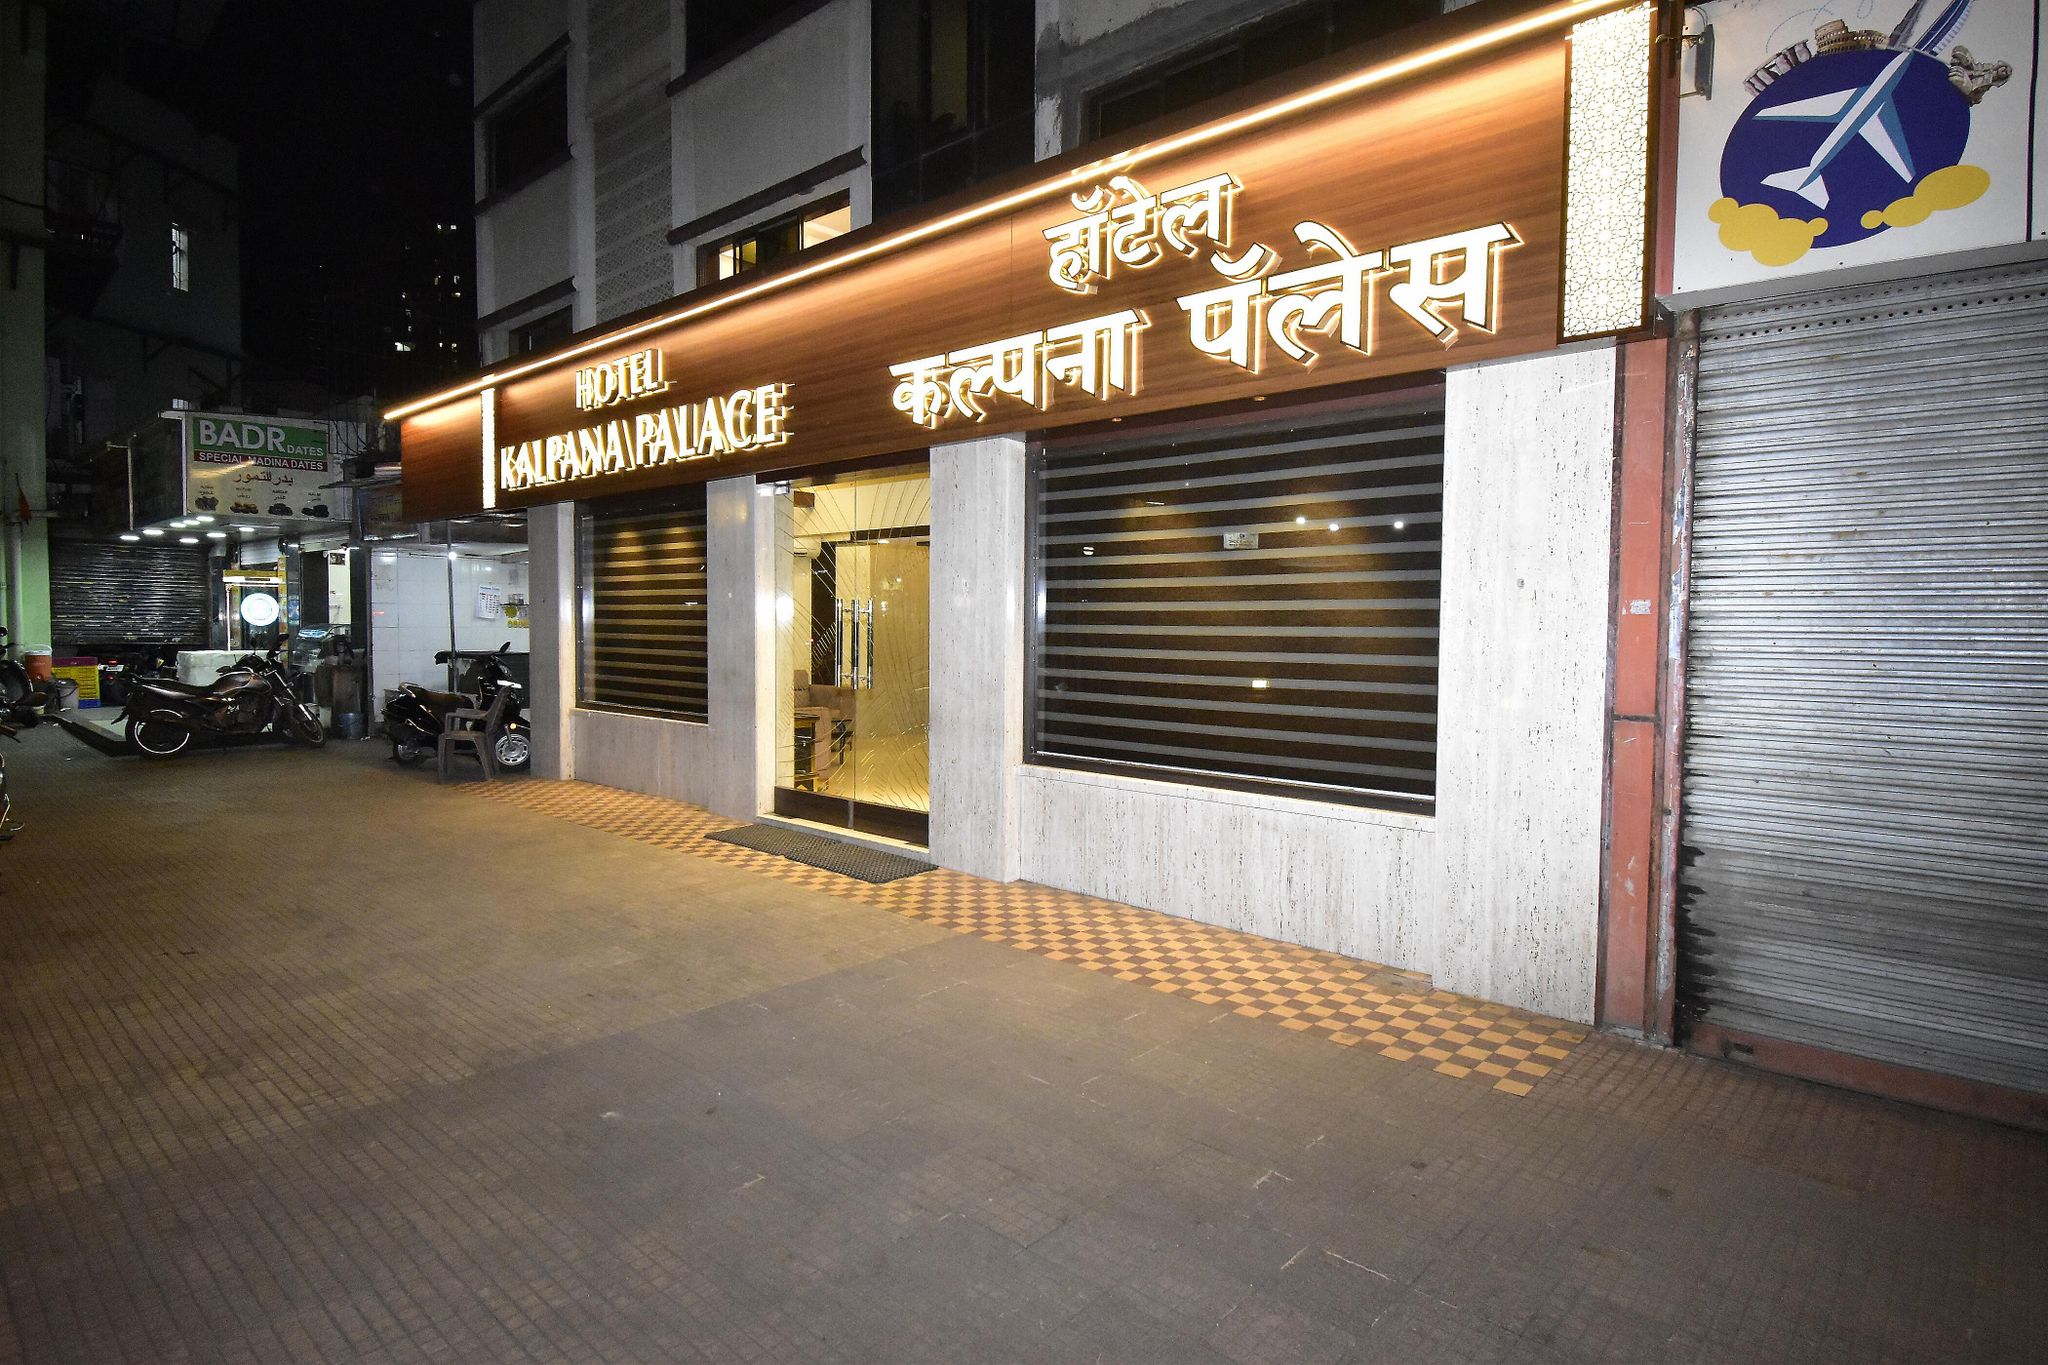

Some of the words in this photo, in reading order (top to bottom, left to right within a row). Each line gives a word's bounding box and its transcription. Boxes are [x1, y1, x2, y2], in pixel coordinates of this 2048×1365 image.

[1042, 172, 1241, 293] हॉटेल
[888, 308, 1149, 428] कल्पना
[1176, 221, 1520, 374] पॅलेस
[575, 348, 669, 410] HOTEL
[199, 419, 286, 453] BADR
[287, 445, 324, 457] DATES
[199, 451, 242, 464] SPECIAL
[249, 456, 289, 469] MADINA
[290, 460, 324, 471] DATES
[501, 419, 632, 490] KALPANA
[635, 383, 788, 466] PALACE
